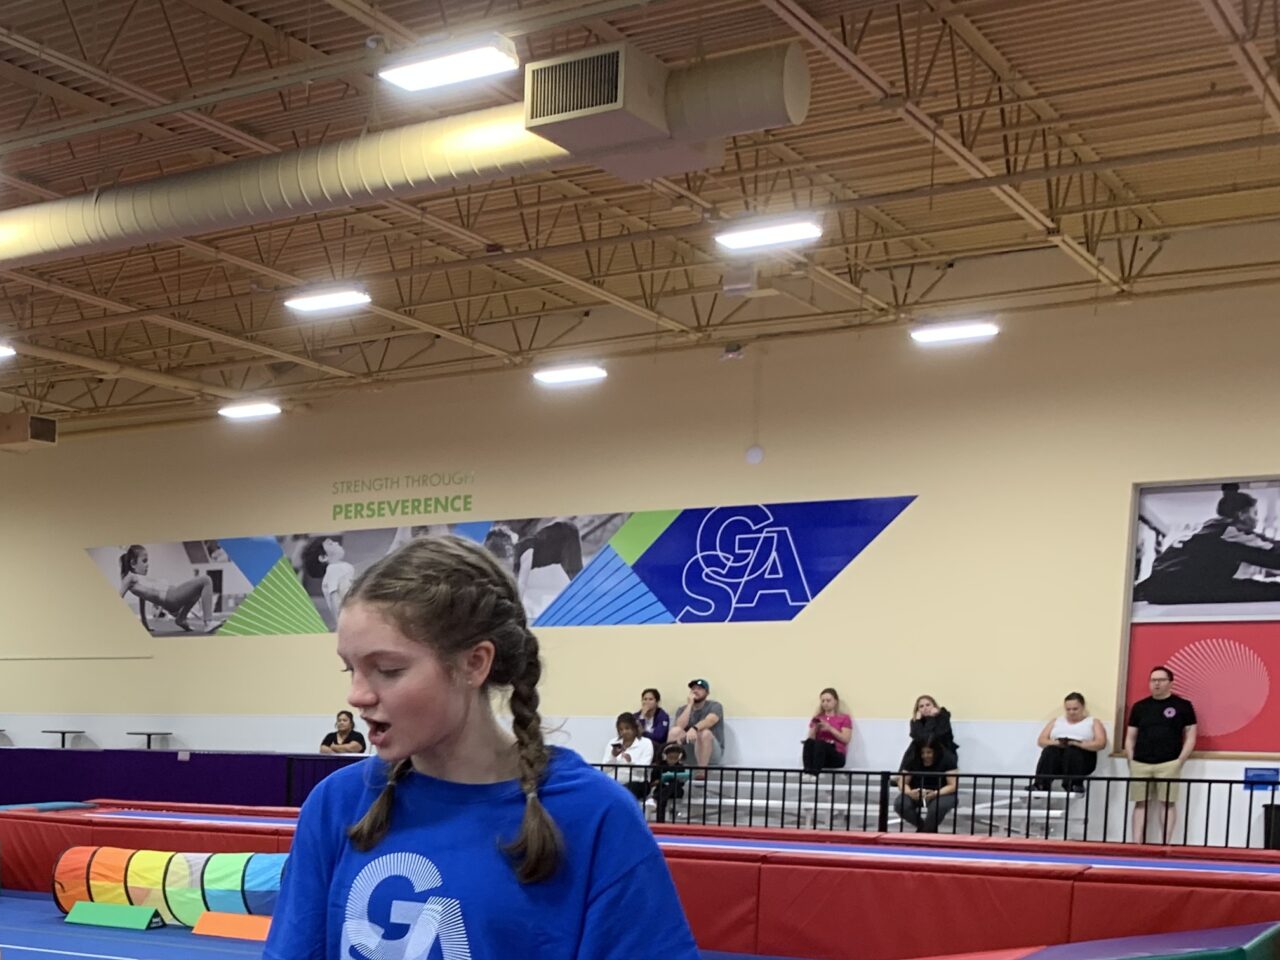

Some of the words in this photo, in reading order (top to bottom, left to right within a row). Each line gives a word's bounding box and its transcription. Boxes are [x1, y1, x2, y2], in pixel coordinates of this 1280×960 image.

[332, 476, 400, 495] STRENGTH
[405, 471, 475, 489] THROUGH
[332, 494, 473, 521] PERSEVERENCE
